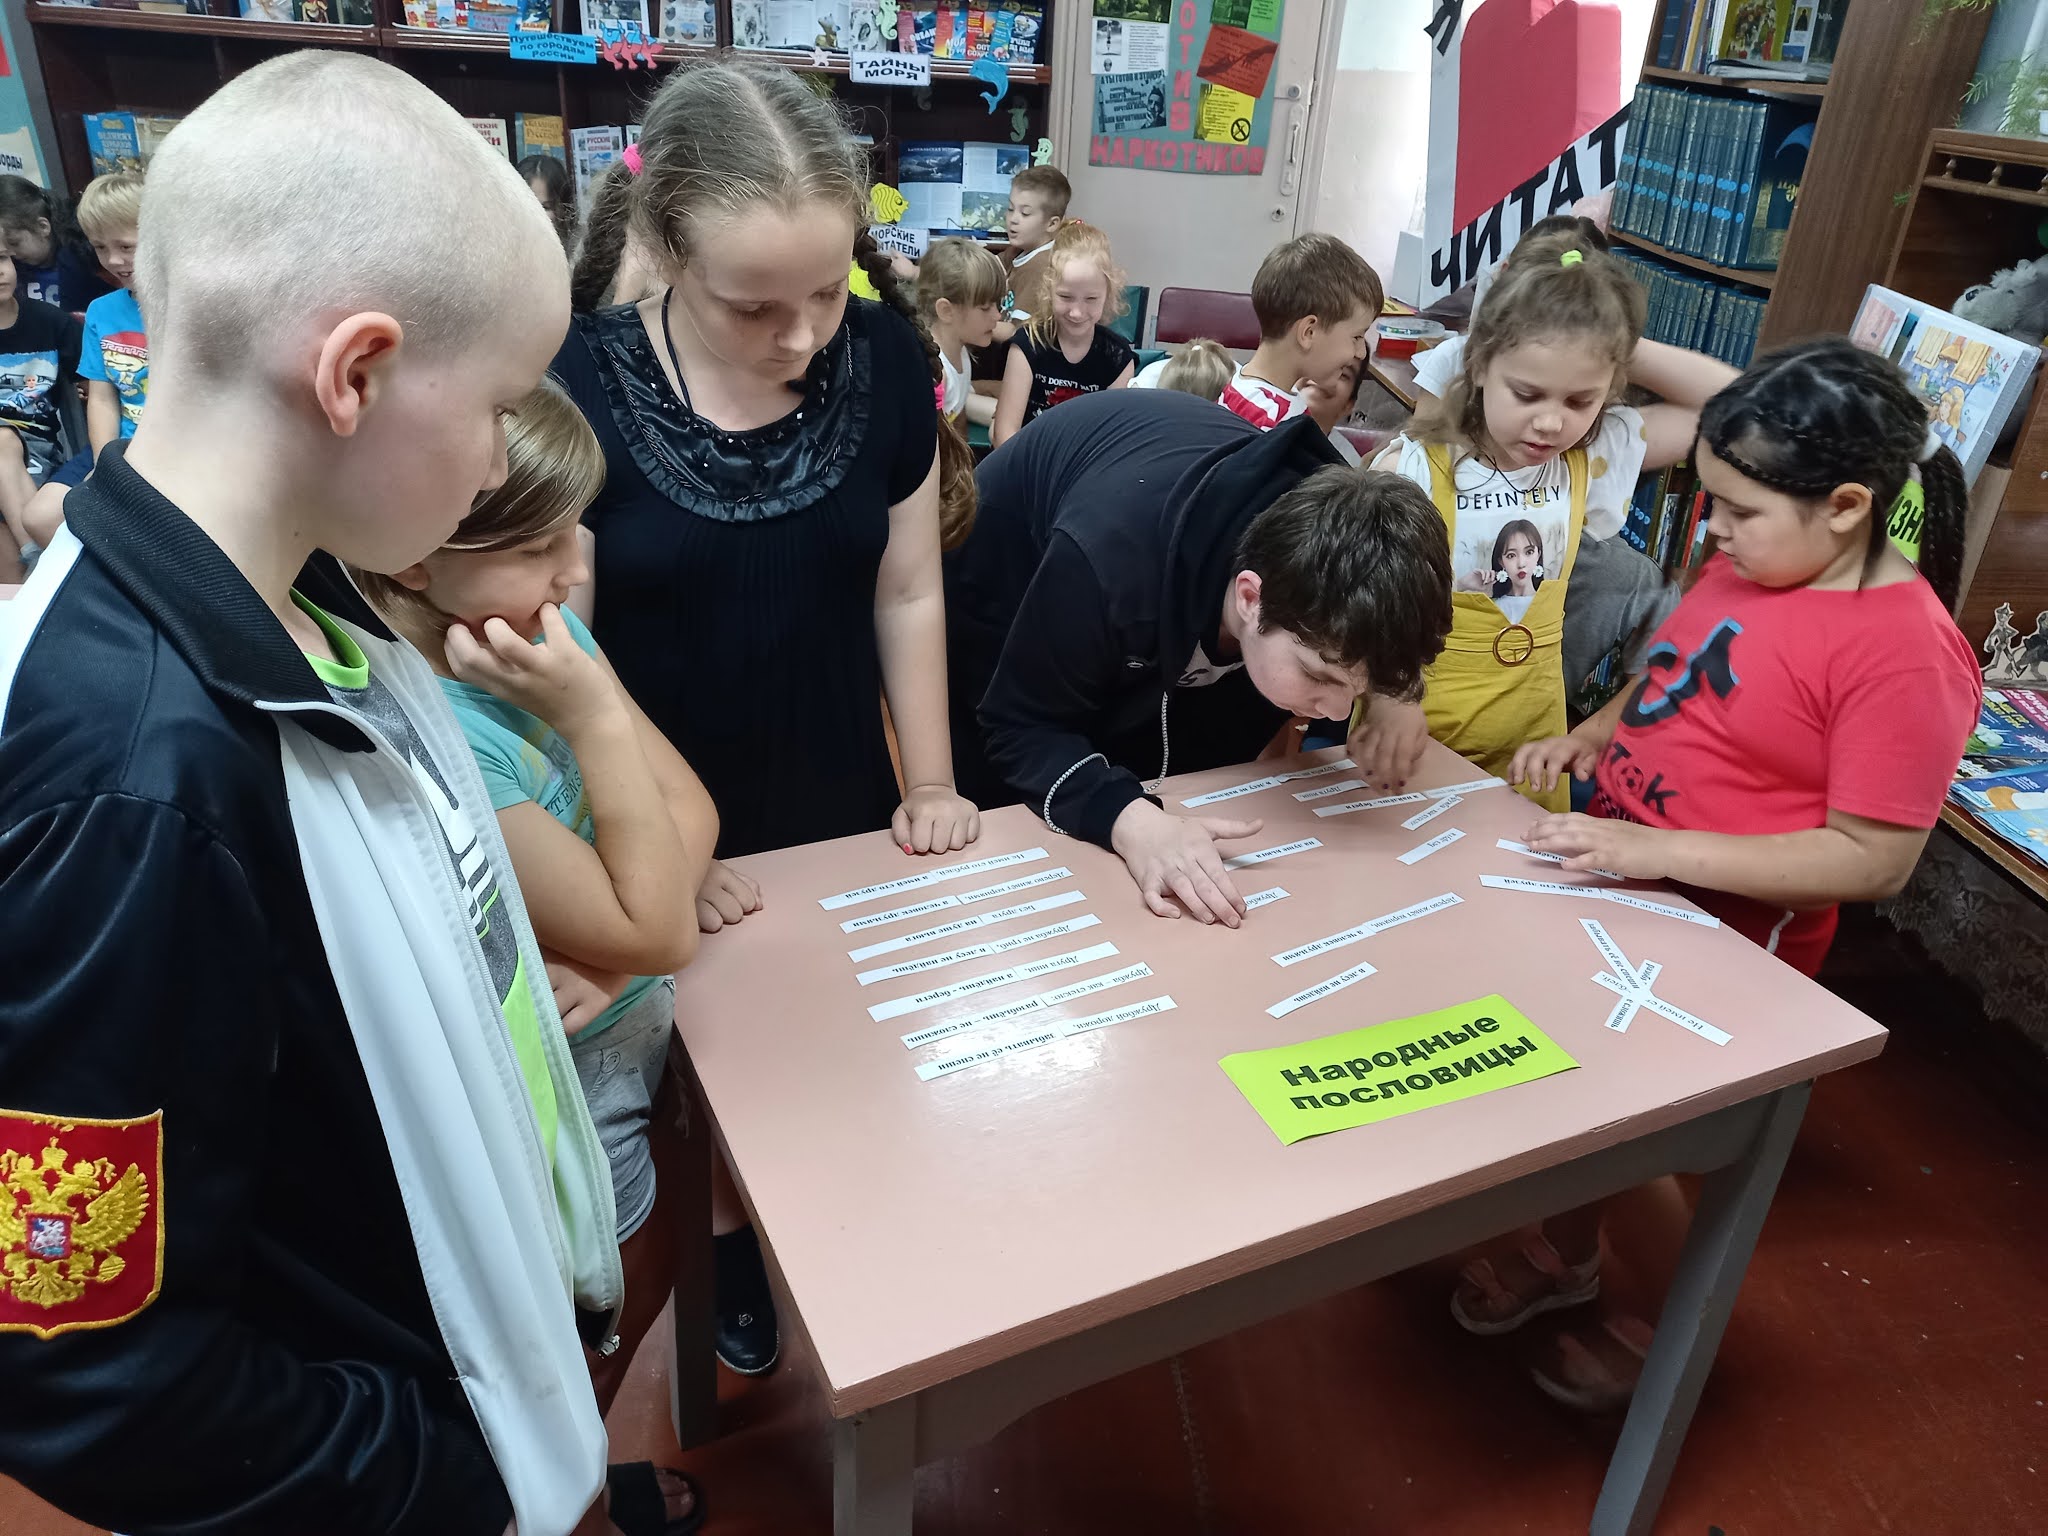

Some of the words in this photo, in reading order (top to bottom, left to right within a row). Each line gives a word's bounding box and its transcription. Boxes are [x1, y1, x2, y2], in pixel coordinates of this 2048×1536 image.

[510, 33, 595, 49] Путешествуем
[520, 43, 534, 51] по
[537, 42, 586, 56] городам
[531, 50, 575, 61] России
[856, 57, 926, 73] ТАЙНЫ
[865, 67, 918, 81] МОРЯ
[1090, 135, 1265, 175] НАРКОТИКОВ
[971, 861, 986, 869] сто
[987, 856, 1011, 865] имей
[896, 877, 921, 887] имей
[1034, 871, 1064, 883] Дерево
[845, 887, 877, 899] друзей
[902, 902, 941, 916] человек
[992, 908, 1017, 919] друга
[853, 911, 899, 927] друзьями
[938, 922, 962, 934] душе
[1035, 925, 1070, 939] Дружба
[905, 930, 936, 942] вьюга
[1323, 931, 1358, 946] человек
[955, 949, 977, 959] лесу
[1282, 944, 1323, 961] друзьями
[1050, 955, 1079, 969] Друга
[1112, 967, 1150, 983] Дружба
[1341, 971, 1358, 983] лесу
[958, 975, 1005, 990] найдёшь
[1330, 979, 1342, 988] не
[915, 990, 951, 1003] береги
[1116, 1003, 1161, 1021] Дружбой
[1659, 1004, 1687, 1021] имей
[1688, 1019, 1704, 1030] Не
[1004, 1033, 1056, 1051] забывать
[976, 1052, 990, 1060] не
[1280, 1016, 1500, 1087] Народные
[938, 1056, 974, 1070] спеши
[1289, 1035, 1539, 1110] пословицы
